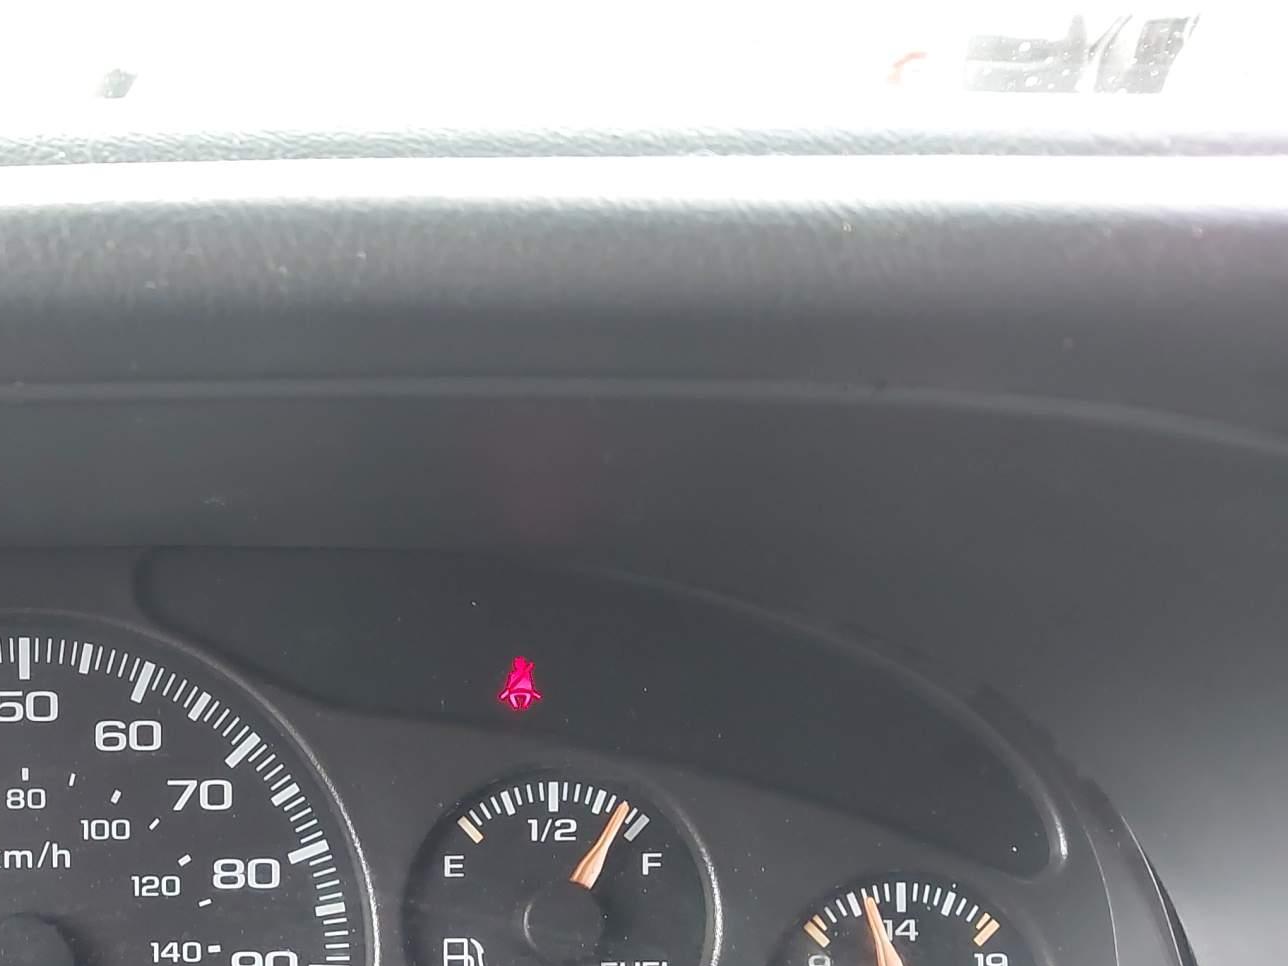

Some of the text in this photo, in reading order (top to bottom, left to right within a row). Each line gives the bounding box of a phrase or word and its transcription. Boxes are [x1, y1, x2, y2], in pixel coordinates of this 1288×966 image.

[95, 720, 163, 751] 60
[6, 789, 47, 811] 80
[167, 779, 233, 811] 70
[81, 819, 131, 842] 100
[527, 817, 578, 843] 1/2
[212, 857, 281, 889] 80
[444, 855, 465, 878] E
[642, 852, 663, 875] F
[131, 875, 181, 898] 120
[883, 918, 919, 942] 14
[150, 941, 203, 964] 140
